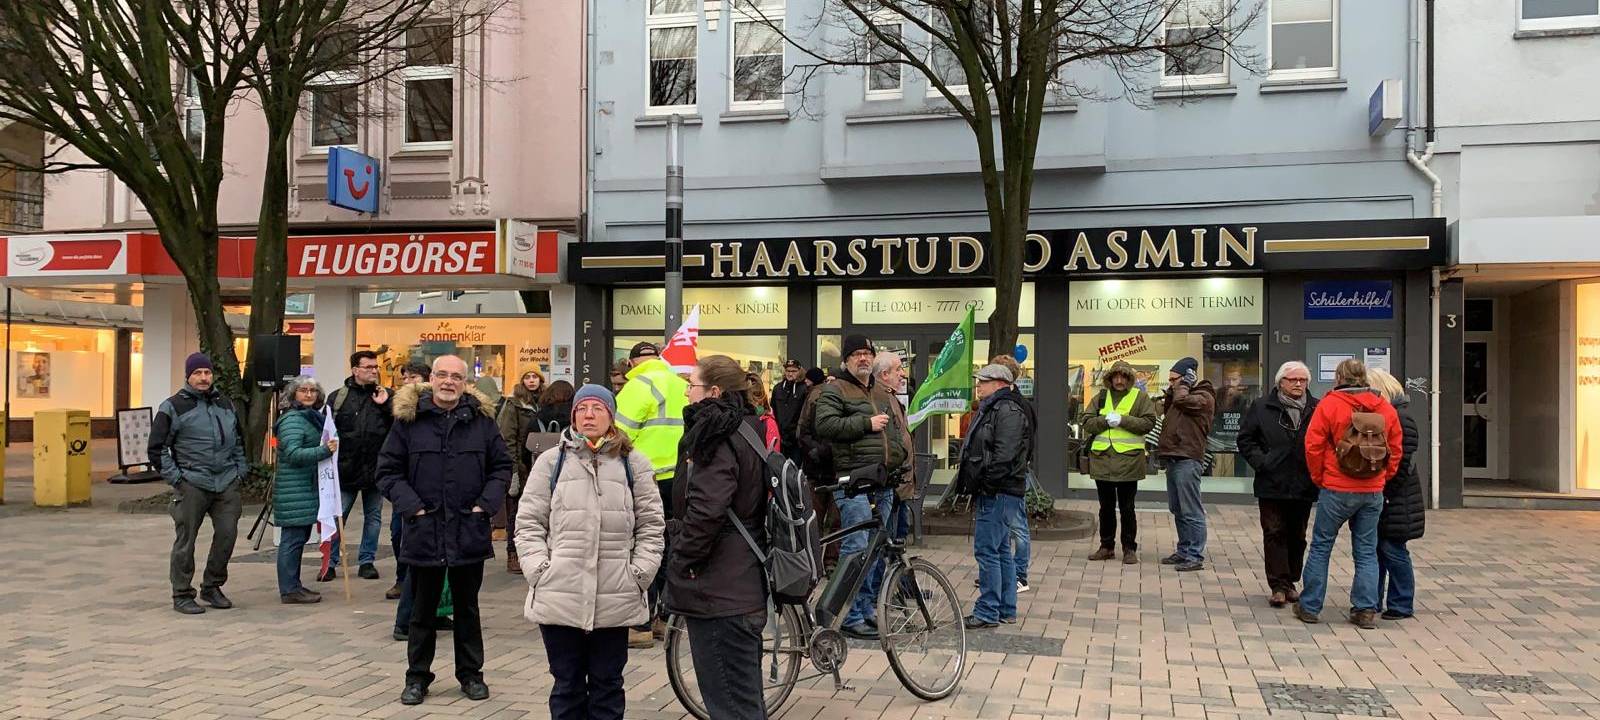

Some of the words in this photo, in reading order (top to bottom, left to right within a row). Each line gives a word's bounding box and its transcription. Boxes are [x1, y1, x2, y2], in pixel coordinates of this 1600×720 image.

[299, 234, 488, 275] FLUGBÖRSE
[710, 233, 1052, 278] HAARSTUDO
[1063, 227, 1258, 270] ASMIN
[620, 303, 662, 315] DAMEN
[681, 303, 721, 315] EREN
[735, 302, 780, 314] KINDER
[891, 301, 922, 312] 02041
[936, 300, 961, 312] 7777
[1076, 298, 1101, 310] MIT
[1107, 298, 1146, 310] ODER
[1151, 297, 1194, 309] OHNE
[1199, 295, 1255, 308] TERMIN
[1446, 314, 1457, 328] 3
[419, 331, 487, 342] sonnenklar
[1273, 331, 1292, 344] 1a
[519, 347, 549, 355] Angebot
[1098, 334, 1145, 357] HERREN
[1213, 343, 1250, 351] OSSION
[1101, 345, 1148, 364] Haarschnitt
